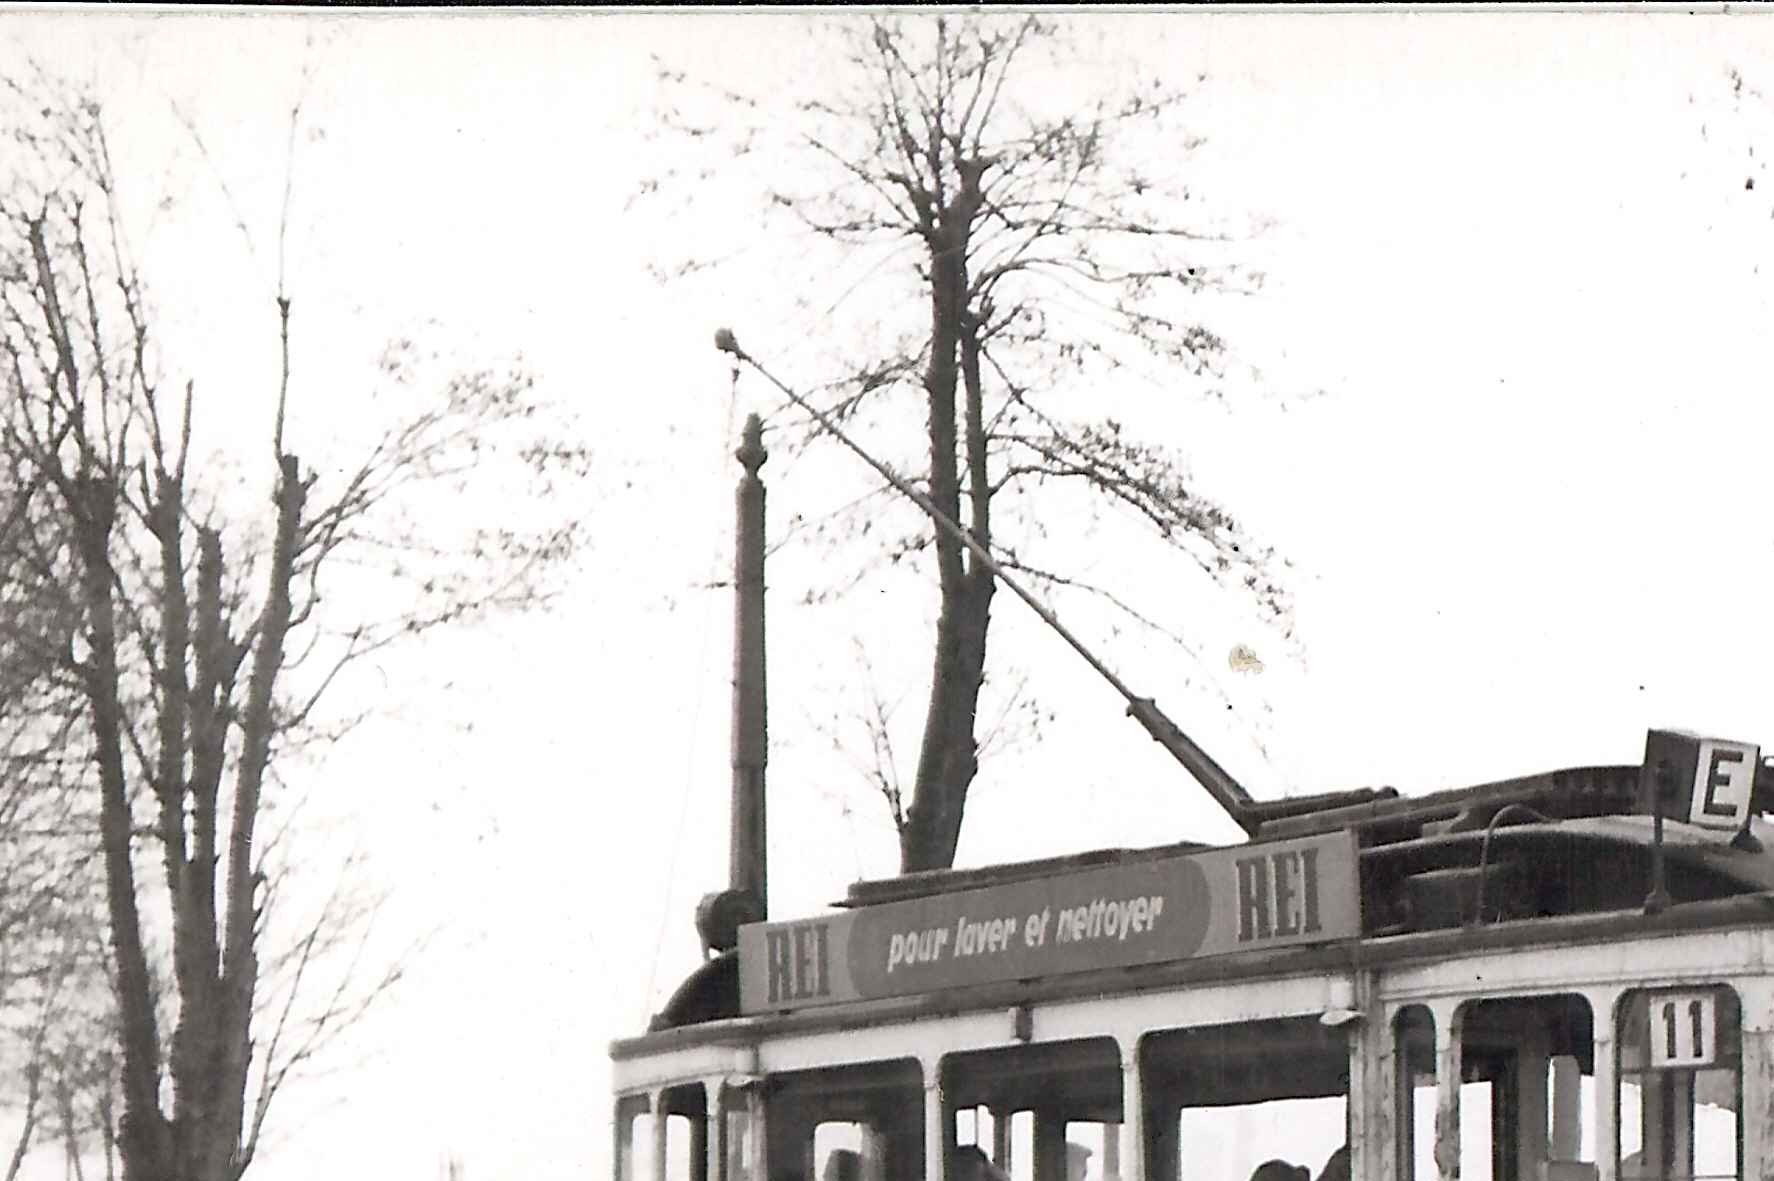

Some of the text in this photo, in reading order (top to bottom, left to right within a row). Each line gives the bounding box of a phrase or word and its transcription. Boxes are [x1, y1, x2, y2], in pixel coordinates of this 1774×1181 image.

[1703, 748, 1743, 818] E
[887, 927, 949, 973] pour
[953, 915, 1017, 957] laver
[1024, 905, 1049, 947] et
[1055, 896, 1164, 945] nettoyer
[1661, 1000, 1703, 1059] 11
